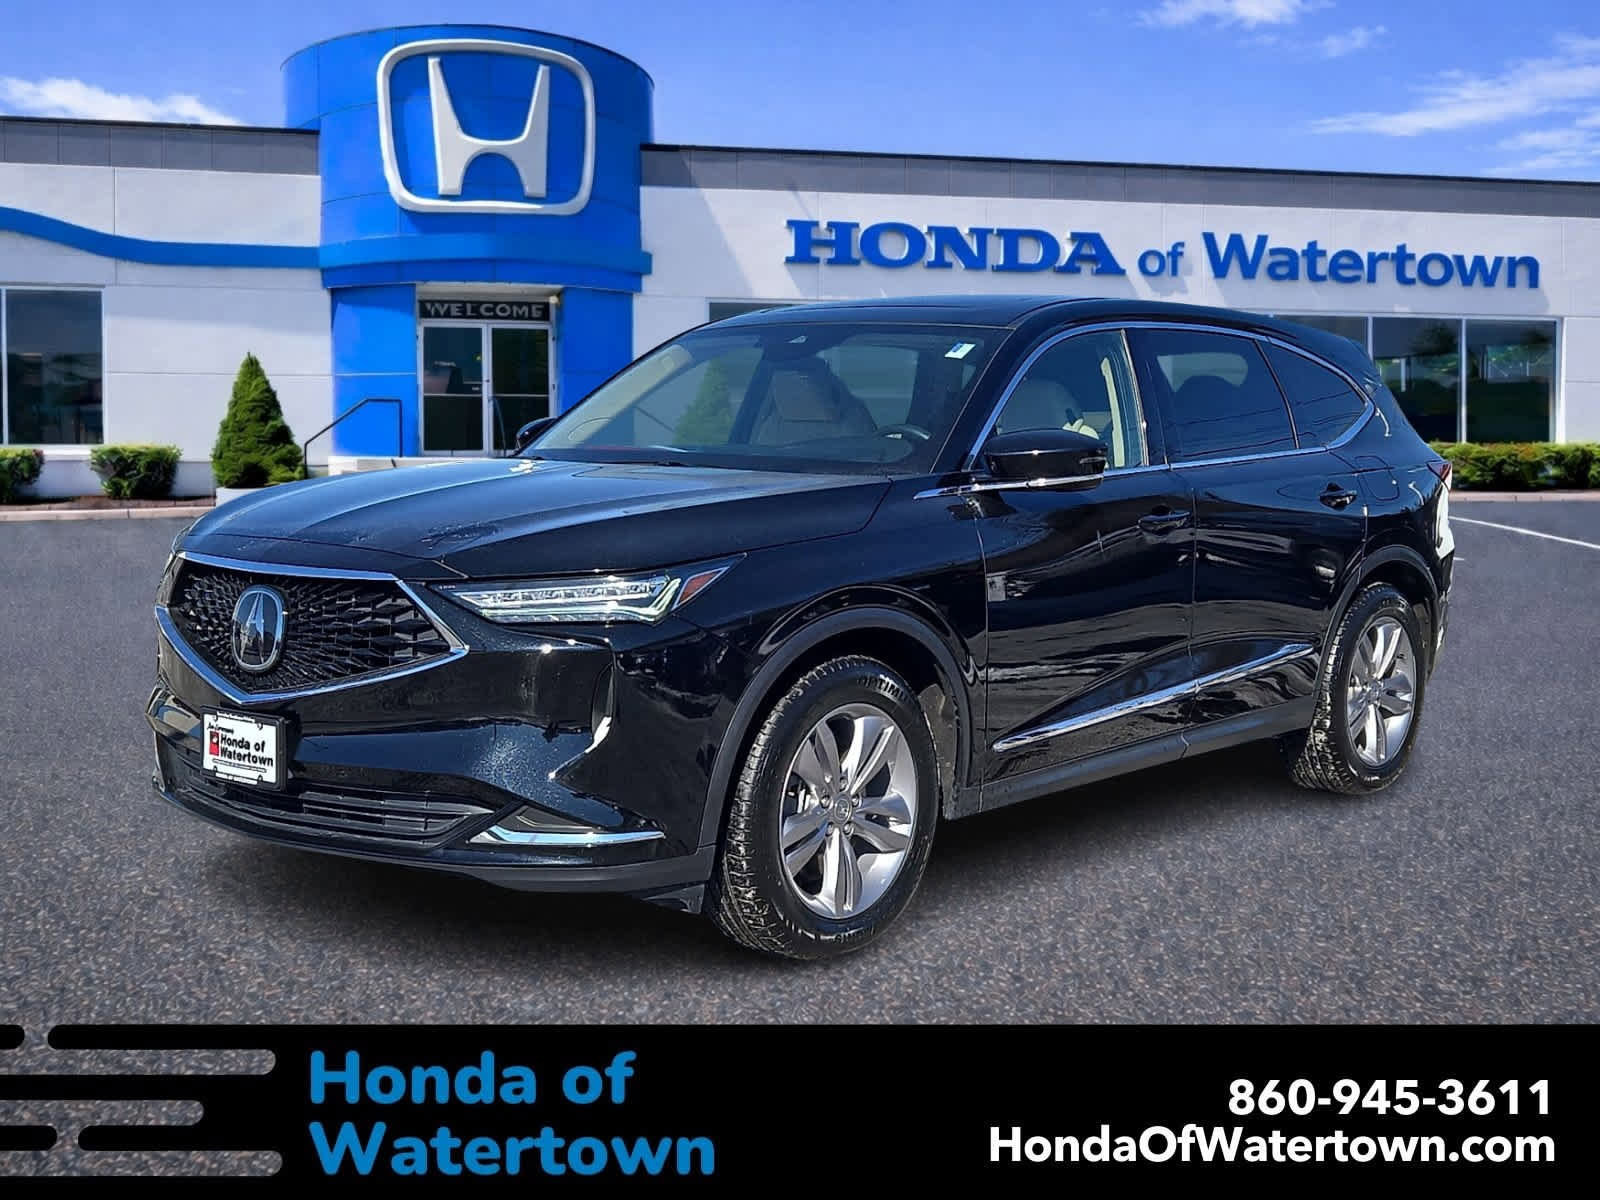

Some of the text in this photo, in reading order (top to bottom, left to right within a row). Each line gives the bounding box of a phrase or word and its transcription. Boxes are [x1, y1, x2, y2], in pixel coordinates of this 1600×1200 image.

[784, 218, 1541, 289] HONDA of Watertown
[425, 302, 544, 318] WELCOME
[220, 734, 266, 753] Honda of
[220, 746, 274, 767] Watertown
